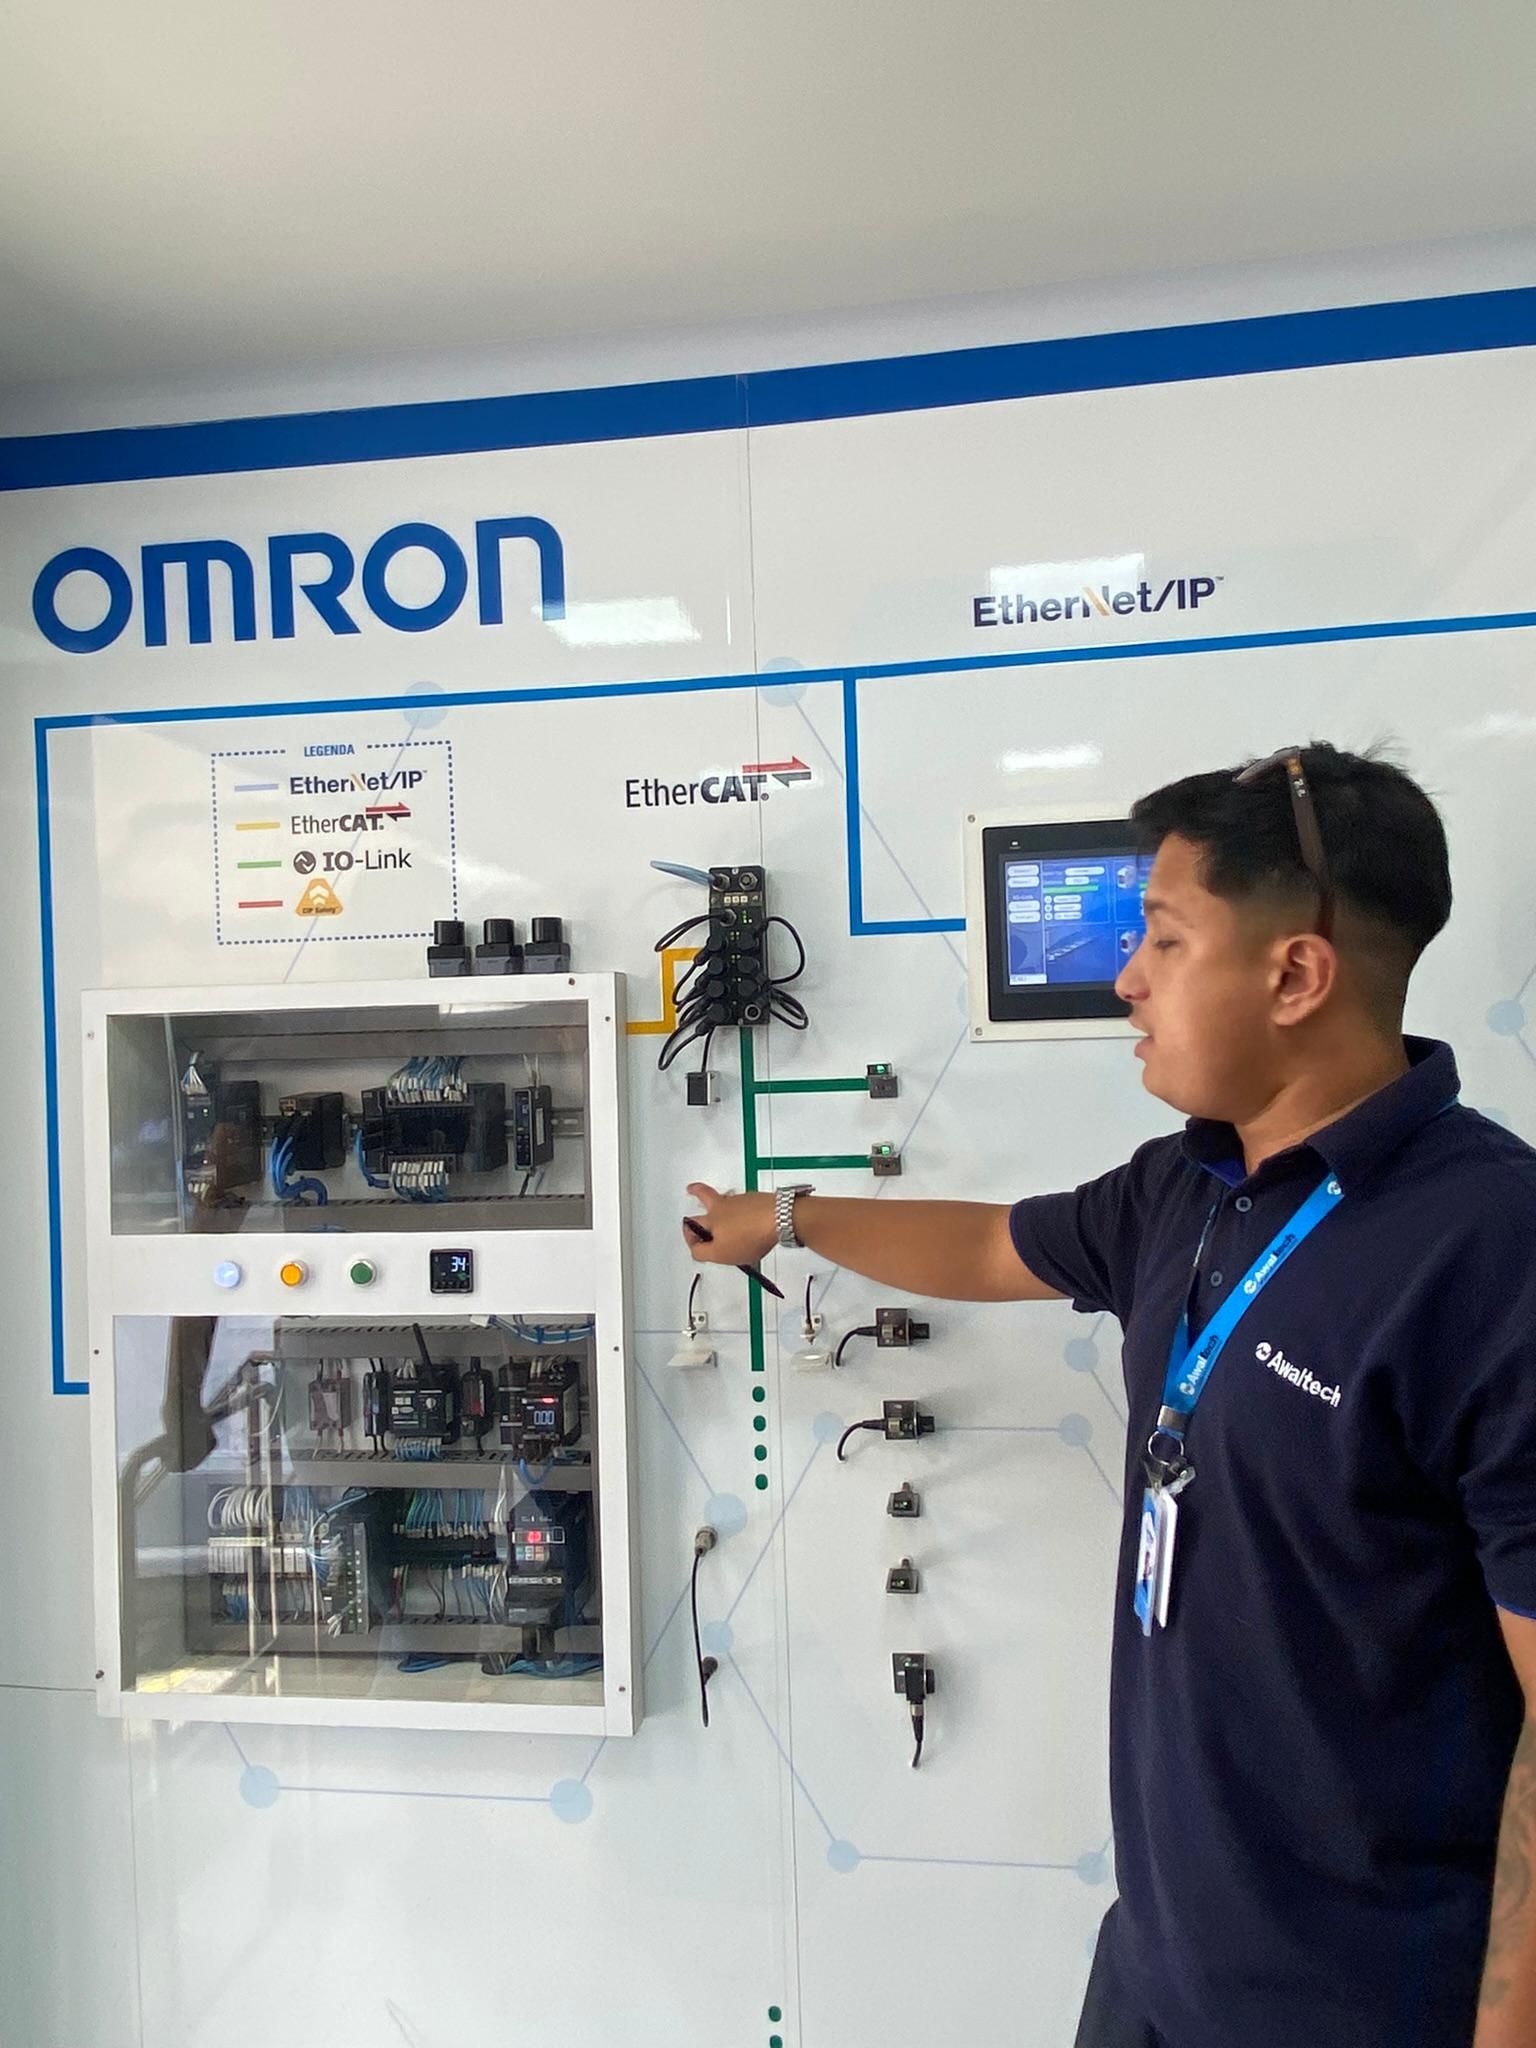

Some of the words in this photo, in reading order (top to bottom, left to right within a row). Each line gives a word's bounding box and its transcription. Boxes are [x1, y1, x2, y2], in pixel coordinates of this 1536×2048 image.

[32, 517, 566, 654] OMRON
[973, 576, 1216, 627] EtherNet/IP
[304, 744, 355, 757] LEGENDA
[290, 770, 422, 794] EtherNet/IP
[323, 848, 412, 871] IO-Link
[451, 1256, 466, 1272] 34
[1267, 1351, 1341, 1408] Awaltech
